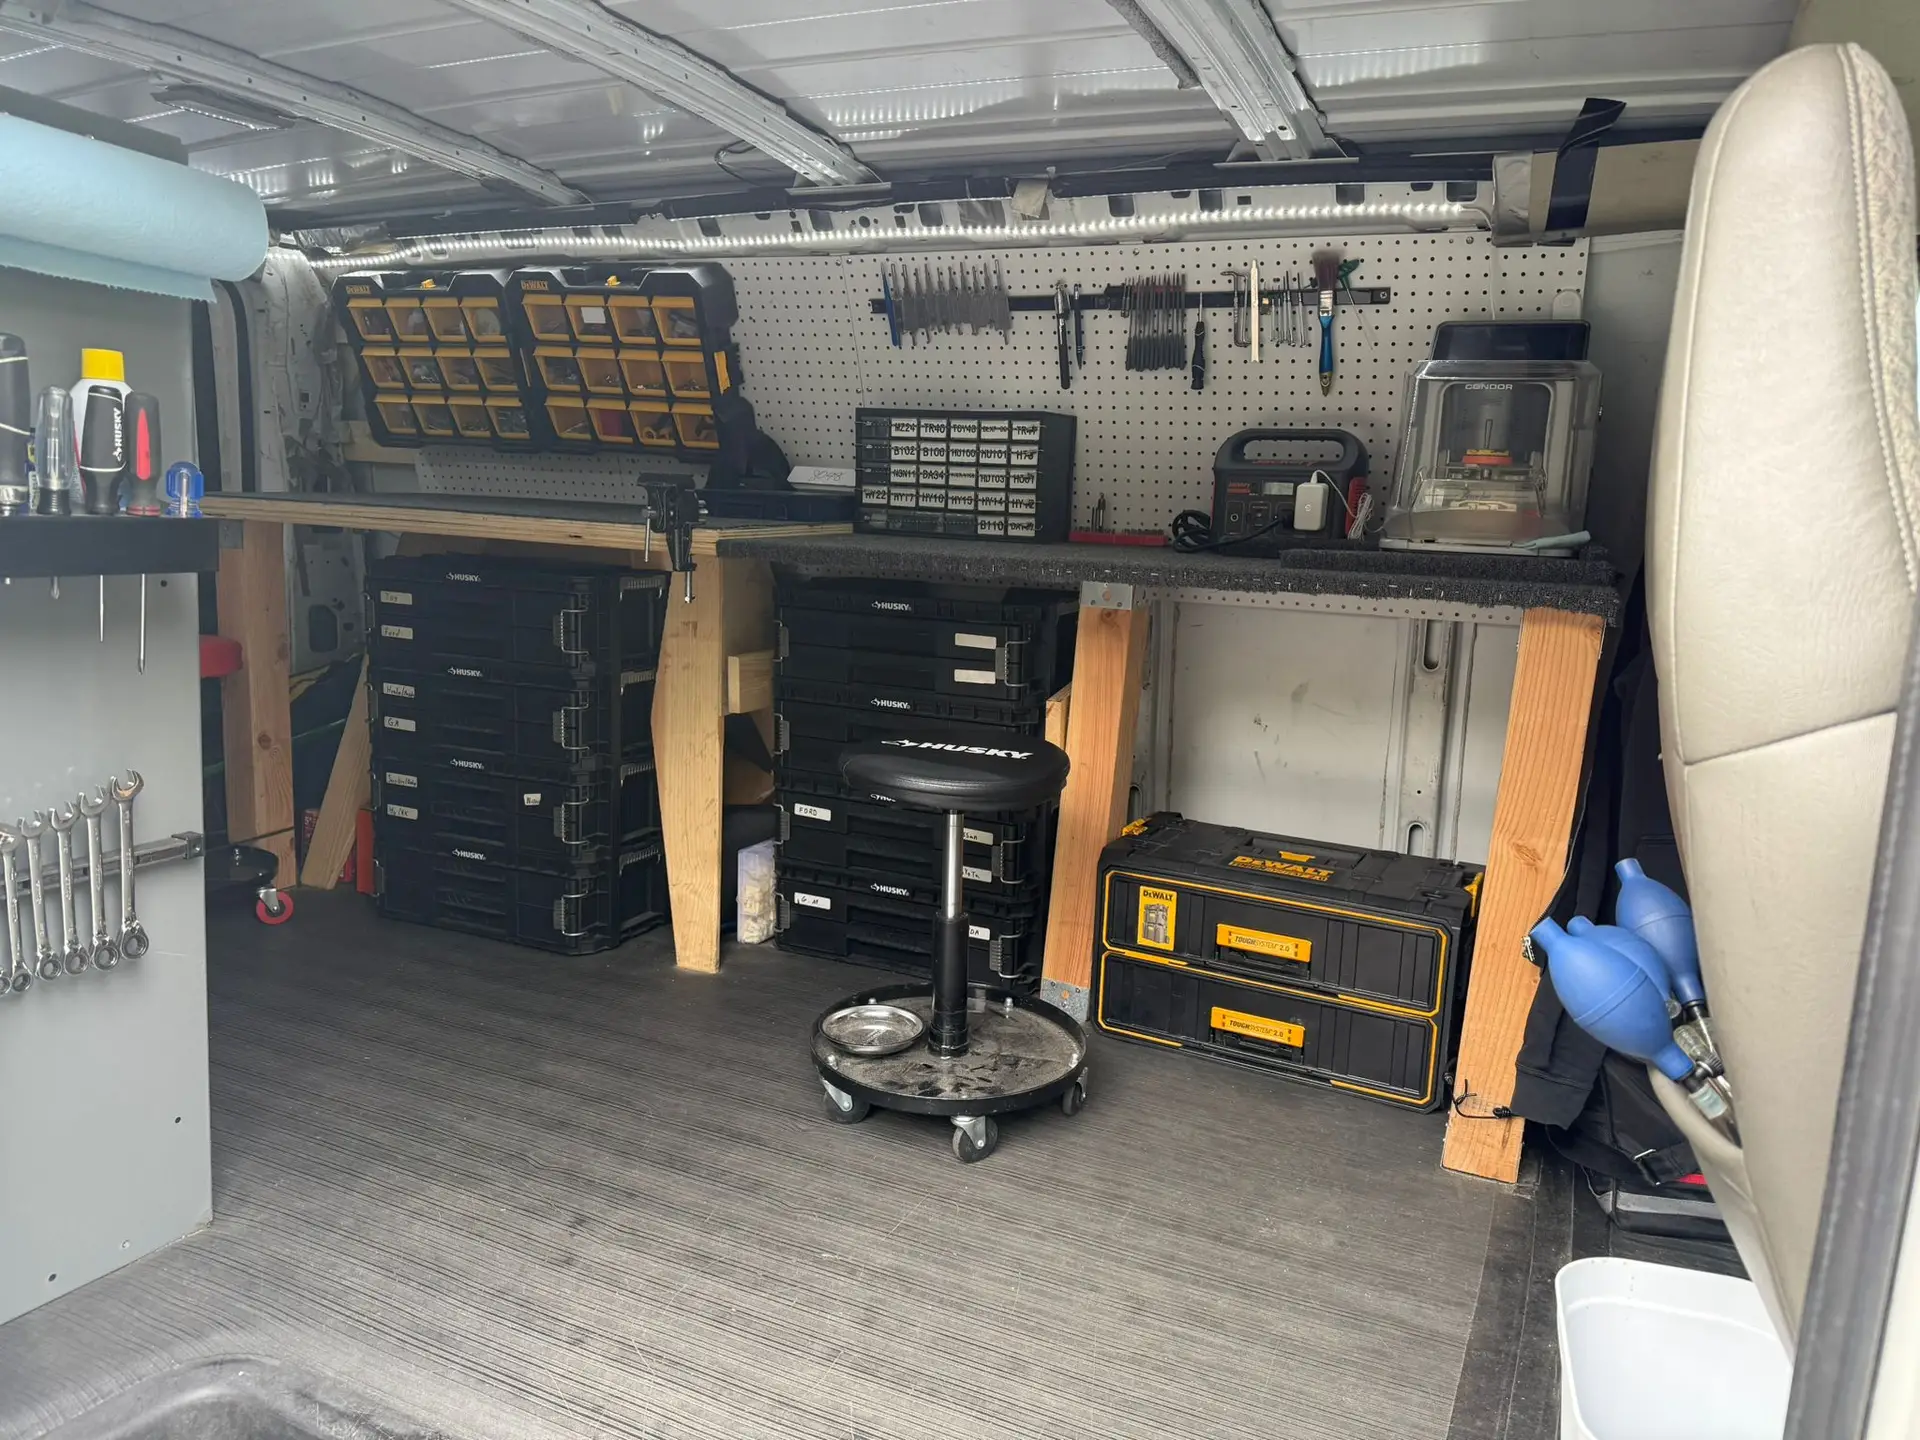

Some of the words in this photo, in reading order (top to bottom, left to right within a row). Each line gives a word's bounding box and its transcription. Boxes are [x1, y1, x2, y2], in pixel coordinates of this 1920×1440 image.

[113, 408, 122, 446] HUSKY
[454, 573, 480, 582] HUSKY
[881, 601, 909, 611] HUSKY
[456, 668, 481, 677] HUSKY
[880, 700, 908, 709] HUSKY
[917, 742, 1033, 759] HUSKY
[458, 761, 482, 770] HUSKY
[460, 850, 484, 861] HUSKY
[1232, 855, 1335, 876] DEWALT
[880, 885, 908, 896] HUSKY
[1143, 889, 1174, 902] DEWALT
[1279, 944, 1290, 952] 2.0
[1274, 1029, 1284, 1038] 2.0
